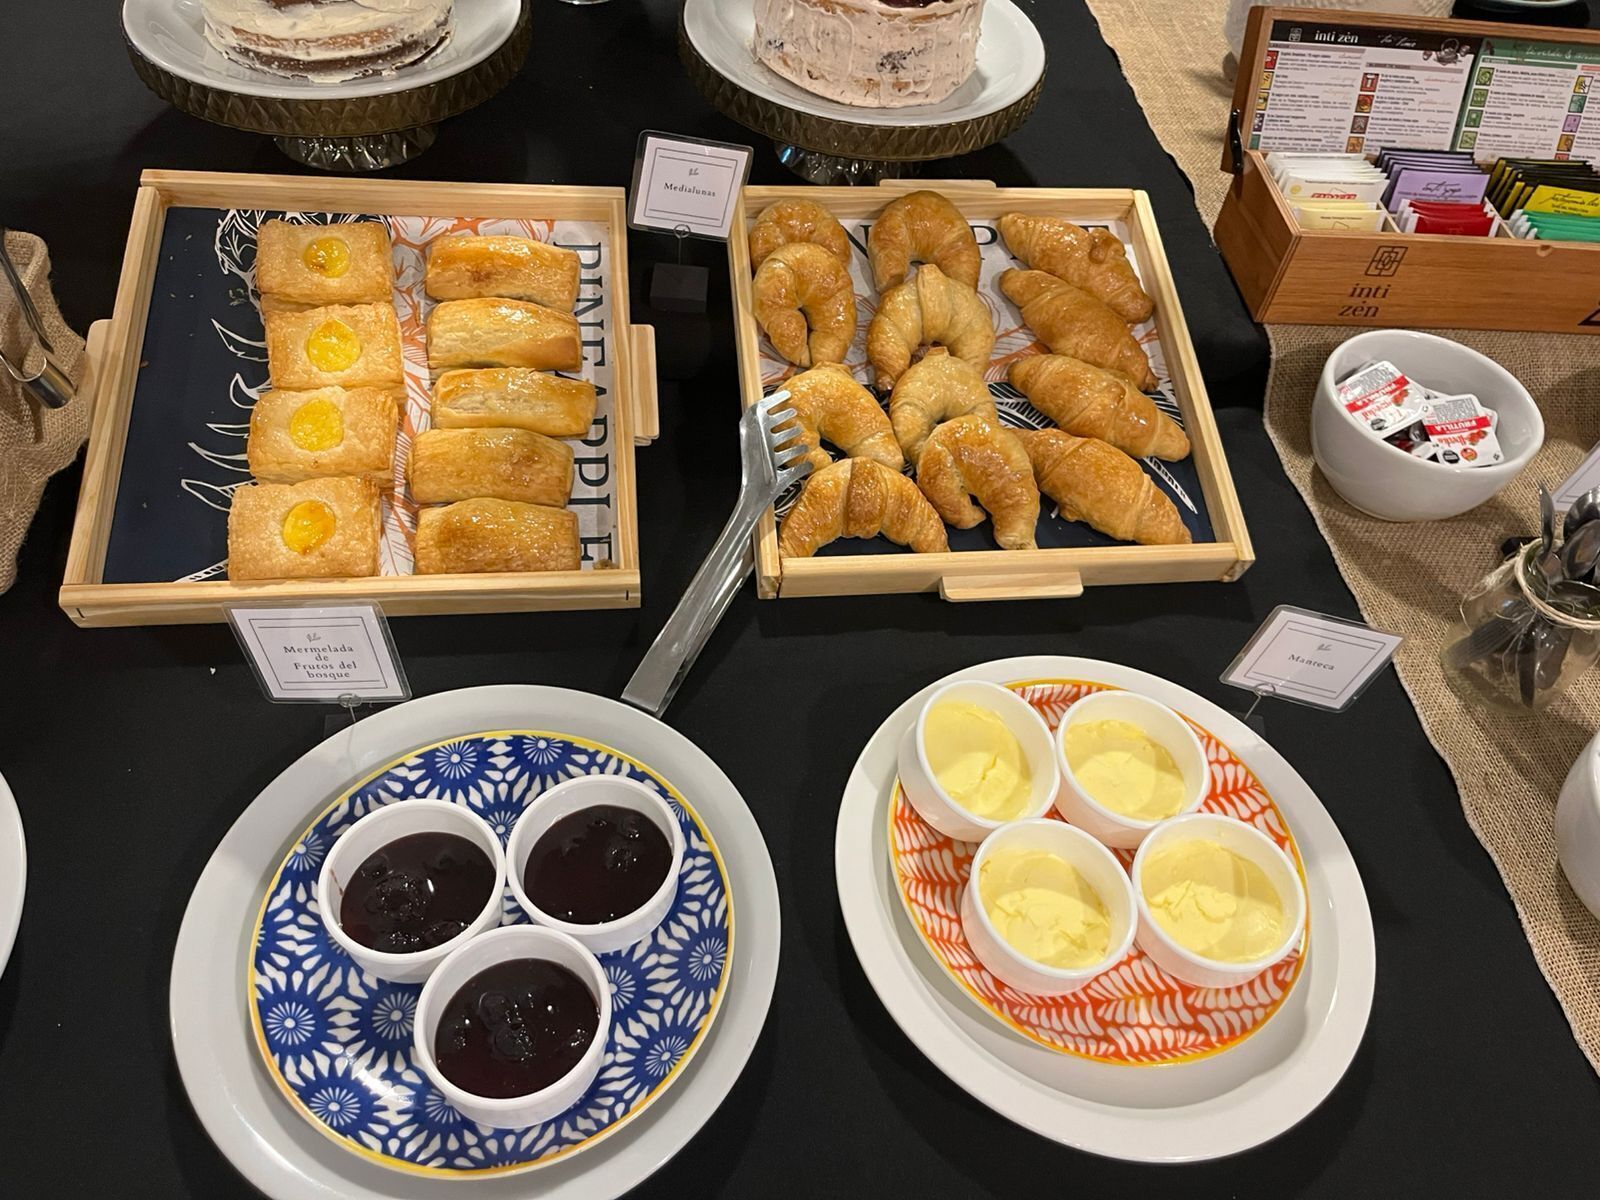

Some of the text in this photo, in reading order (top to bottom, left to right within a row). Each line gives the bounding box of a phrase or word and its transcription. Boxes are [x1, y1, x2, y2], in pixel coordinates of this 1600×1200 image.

[1314, 30, 1336, 42] inti
[663, 182, 716, 198] Medialunas
[1348, 283, 1391, 298] inti
[1435, 420, 1477, 434] FRUTILLA
[283, 643, 354, 654] Mermelada
[315, 653, 329, 662] de
[1288, 653, 1335, 670] Manteca
[293, 660, 357, 671] Frutos del
[306, 670, 351, 681] bosque
